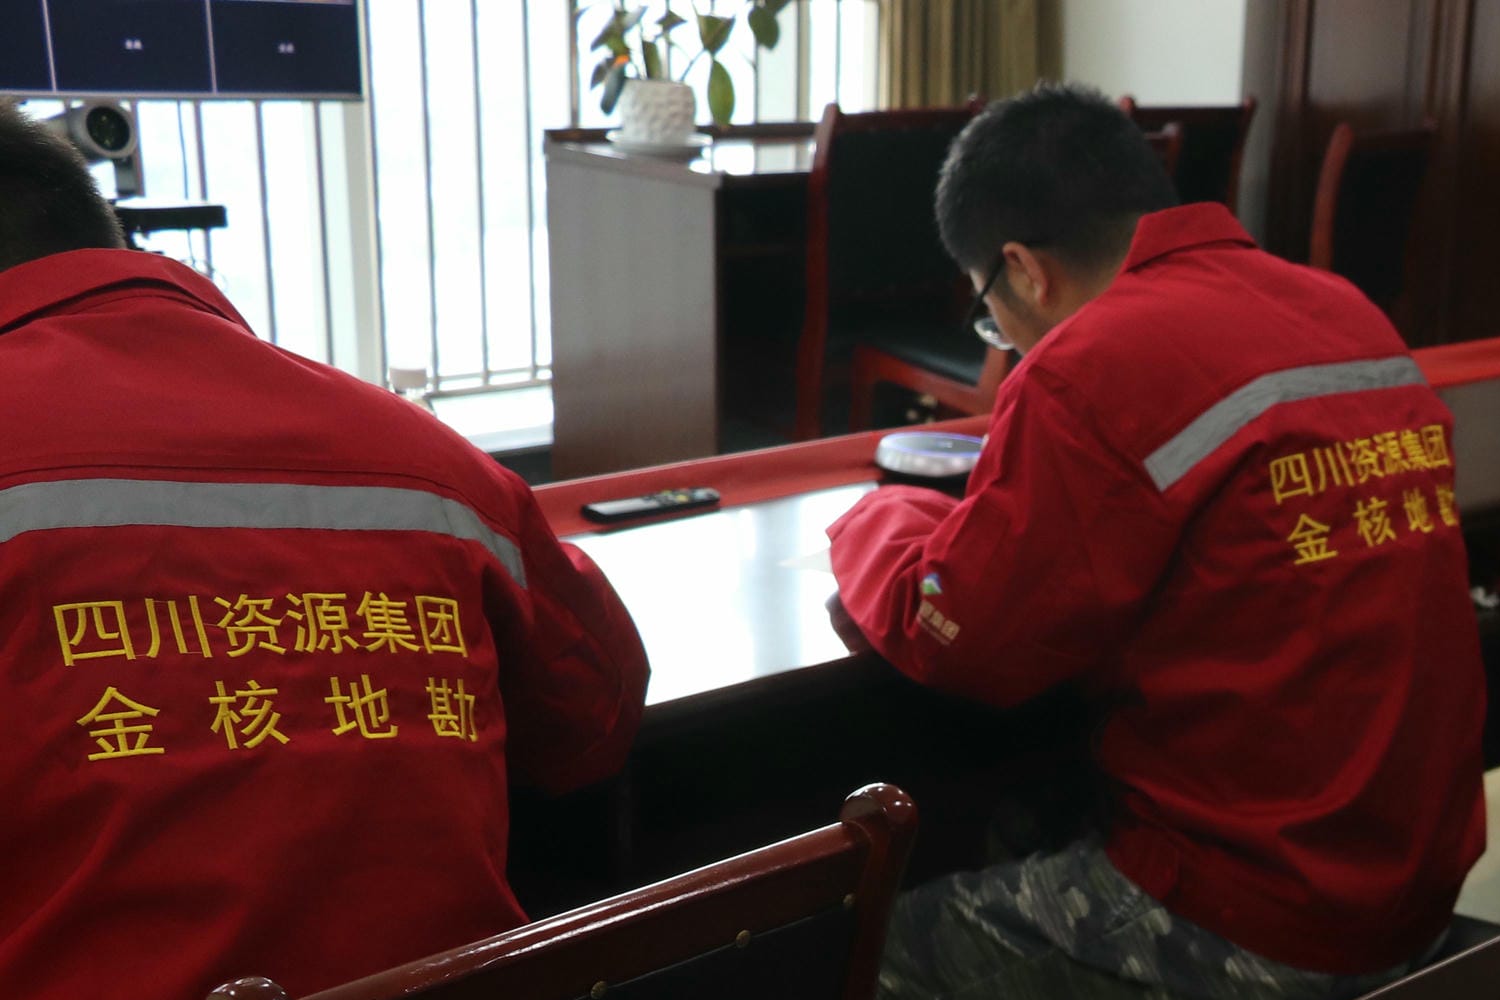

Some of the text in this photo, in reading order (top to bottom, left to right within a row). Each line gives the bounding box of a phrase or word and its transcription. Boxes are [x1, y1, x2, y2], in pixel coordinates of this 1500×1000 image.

[1269, 424, 1451, 505] 四川资源集团
[53, 591, 469, 667] 四川资源集团
[77, 674, 479, 761] 金核地勘
